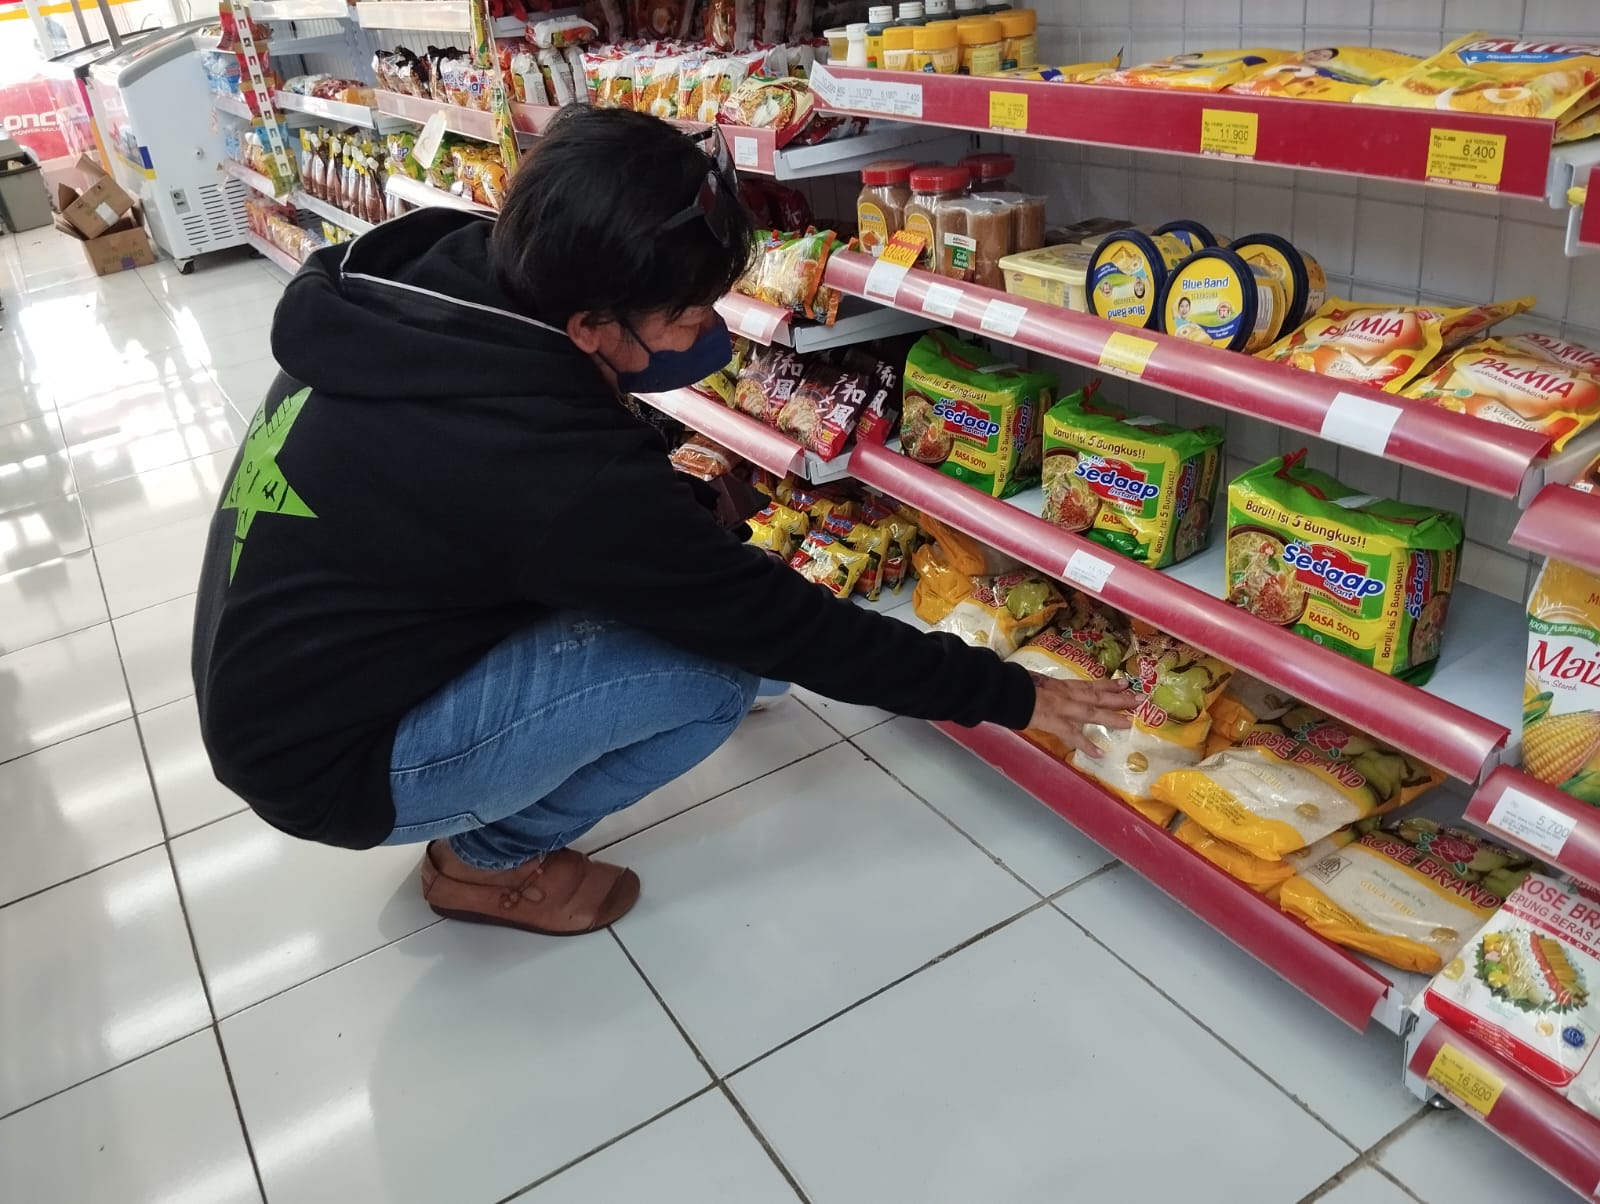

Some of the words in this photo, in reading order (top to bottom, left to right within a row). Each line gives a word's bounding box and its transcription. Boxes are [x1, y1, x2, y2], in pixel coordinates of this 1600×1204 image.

[1182, 279, 1203, 290] Blue
[1204, 276, 1230, 289] Band
[1107, 307, 1128, 319] Band
[1128, 304, 1146, 316] Blue
[942, 381, 950, 390] 5
[1468, 356, 1576, 399] PALMIA
[932, 403, 1000, 436] Sedaap
[954, 450, 970, 463] RASA
[969, 456, 988, 469] SOTO
[1087, 435, 1097, 447] 5
[1096, 439, 1147, 459] Bungkus!!
[1074, 462, 1160, 500] Sedaap
[1101, 513, 1123, 527] RAS
[1245, 500, 1275, 520] Baru!!
[1277, 511, 1290, 525] Isi
[1291, 515, 1303, 528] 5
[1303, 521, 1367, 549] Bungkus!!
[1281, 543, 1386, 597] Sedaap
[1389, 561, 1406, 609] Bungkus!!
[1408, 550, 1425, 620] Sedaa
[1308, 610, 1334, 630] RASA
[1336, 621, 1361, 642] SOTO
[1386, 609, 1399, 618] 5
[1381, 630, 1395, 659] Baru!!
[1055, 642, 1107, 680] BRAND
[1551, 679, 1577, 691] Starch
[1291, 746, 1367, 789] BRAND
[1360, 833, 1420, 865] ROSE
[1414, 856, 1502, 909] BRAND
[1509, 892, 1551, 919] EPUNG
[1549, 912, 1594, 943] BERAS
